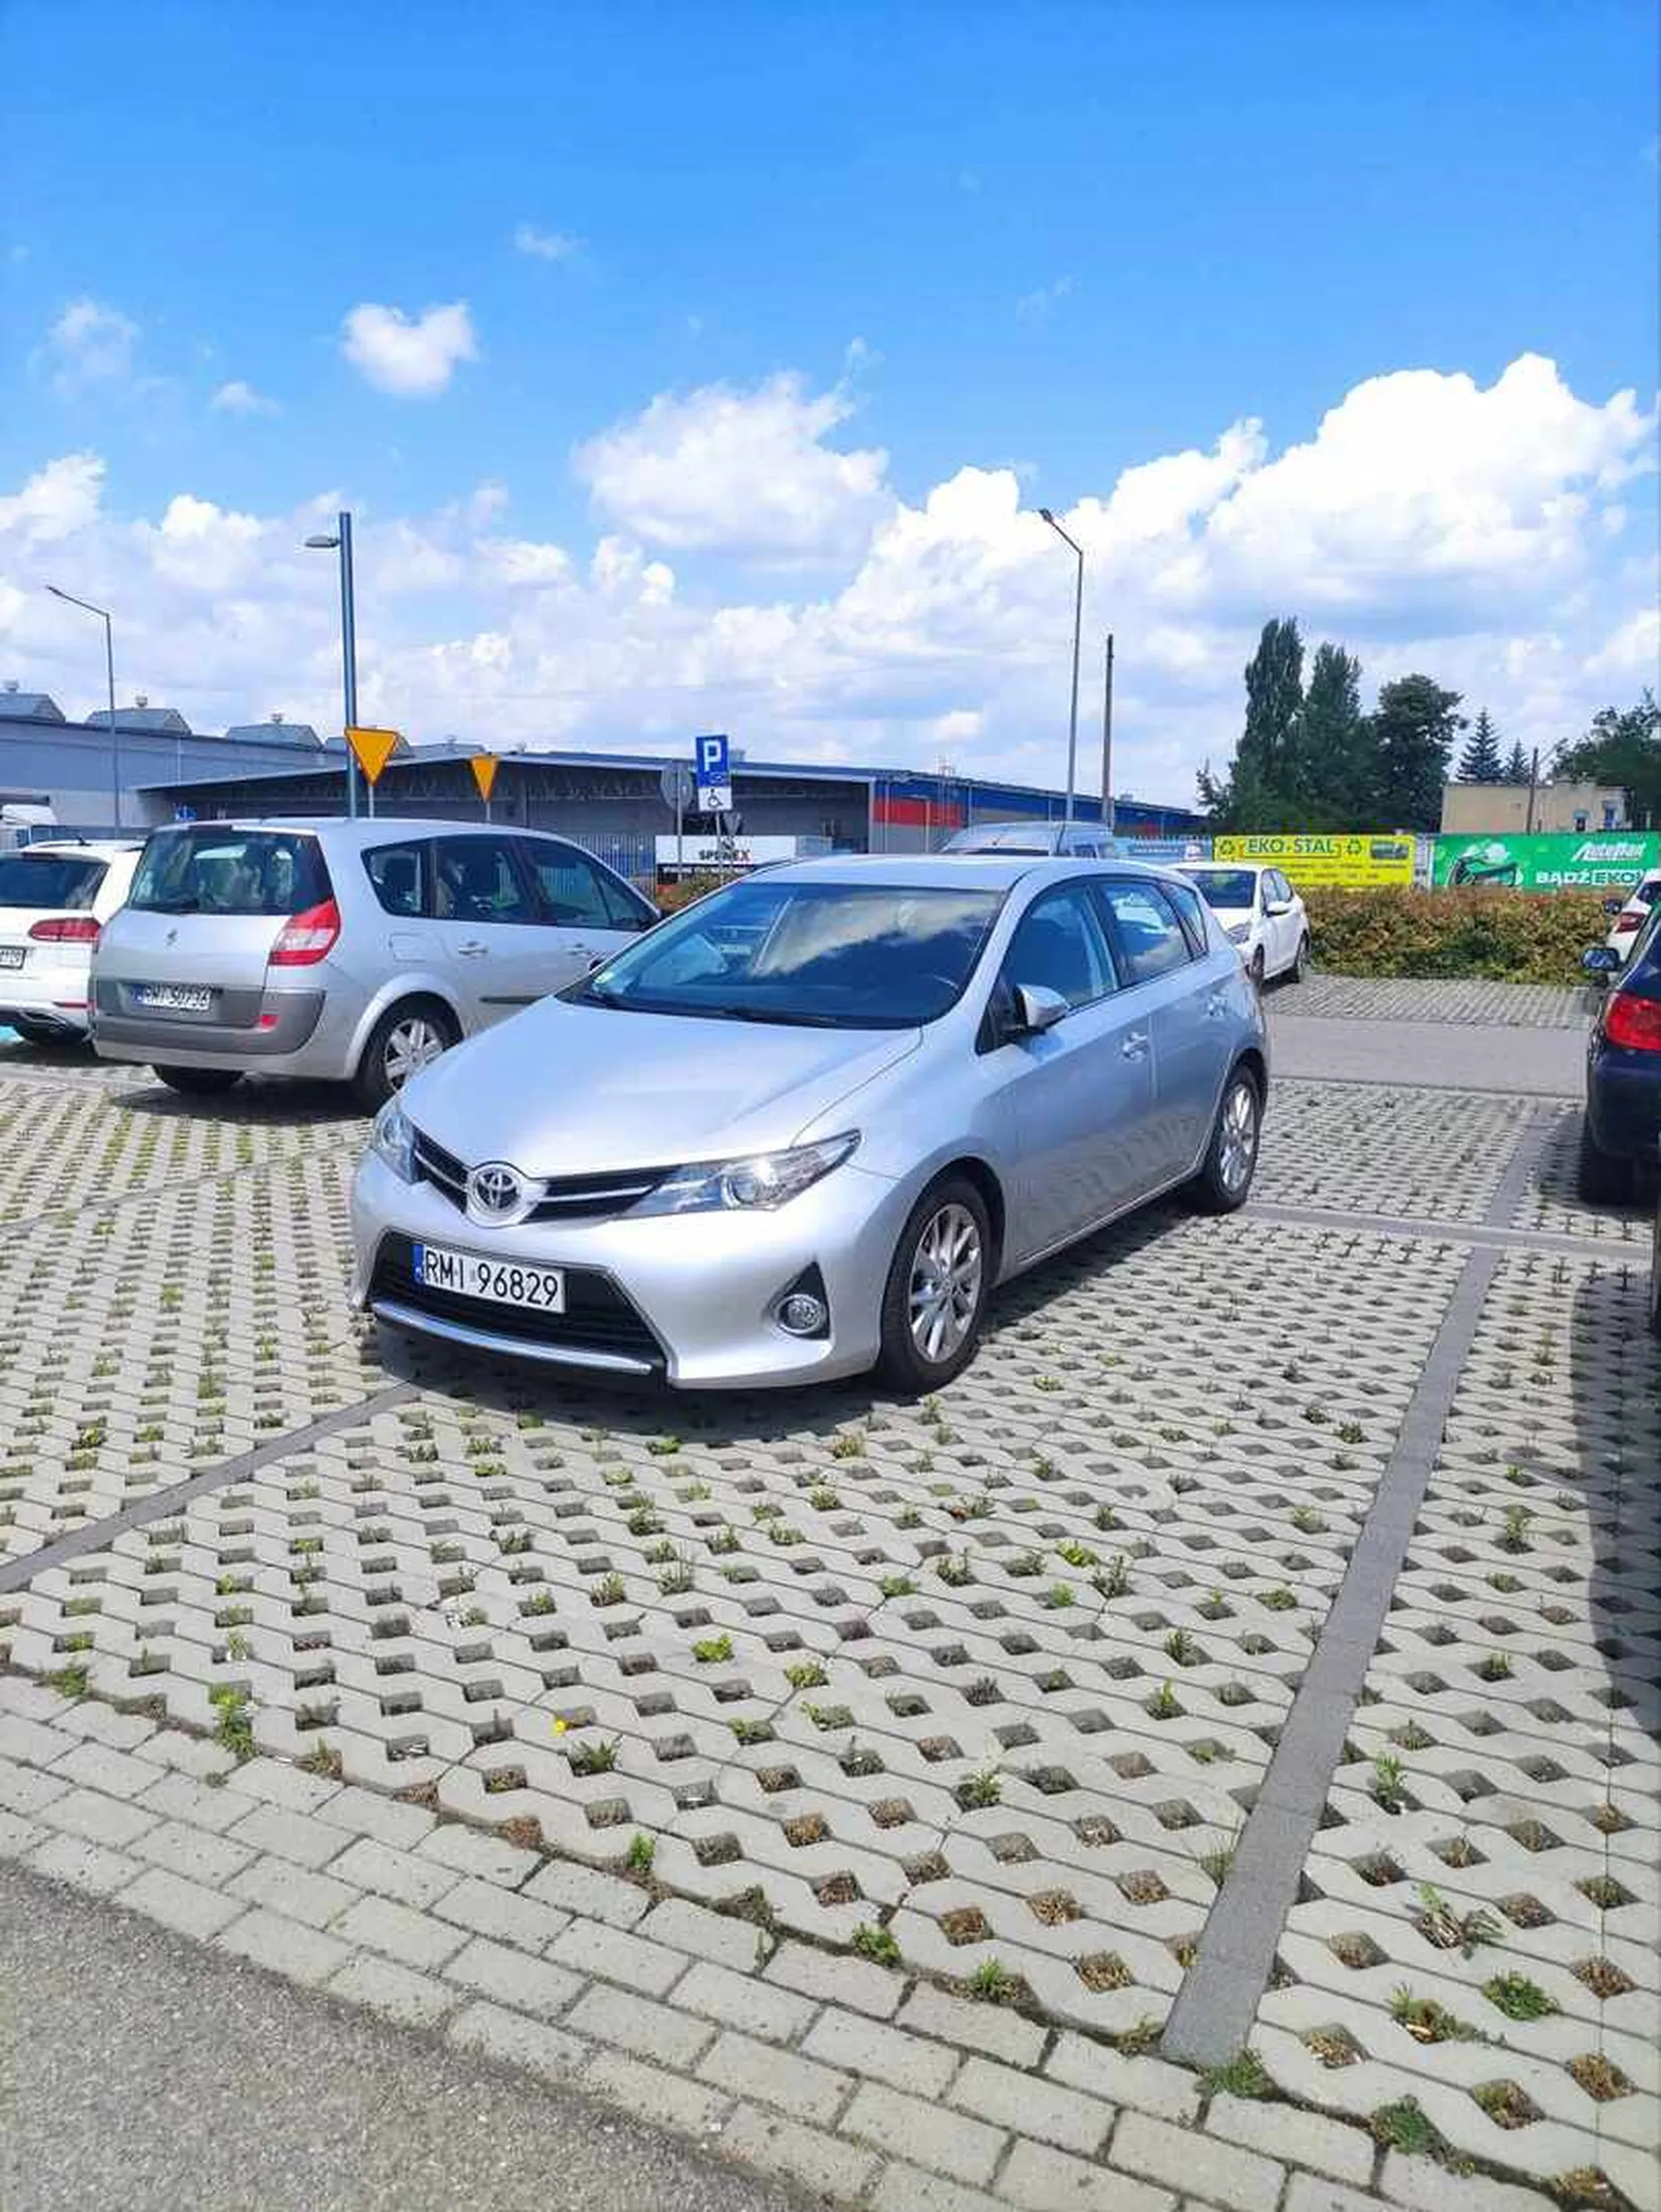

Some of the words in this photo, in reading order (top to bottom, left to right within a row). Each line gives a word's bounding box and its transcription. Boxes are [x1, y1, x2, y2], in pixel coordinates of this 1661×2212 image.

[704, 741, 722, 772] P
[426, 1250, 464, 1290] RMI
[478, 1263, 558, 1306] 96829
